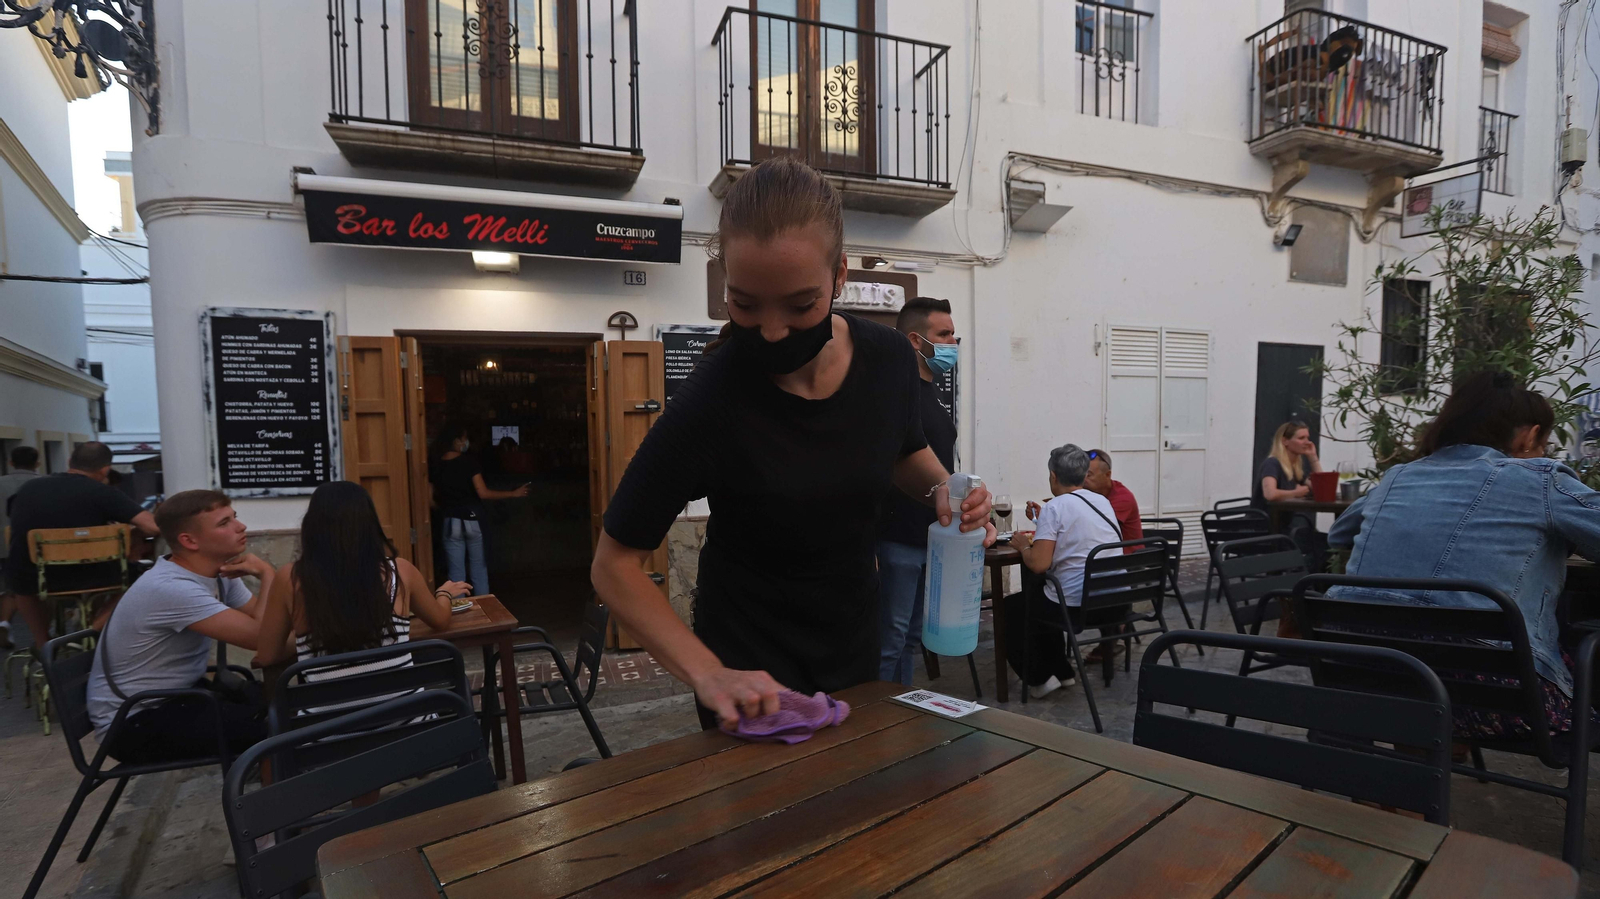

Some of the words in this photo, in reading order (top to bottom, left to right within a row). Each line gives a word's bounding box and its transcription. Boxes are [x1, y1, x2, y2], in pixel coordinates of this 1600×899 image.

[335, 204, 397, 236] Bar
[408, 212, 450, 240] los
[463, 213, 548, 244] Melli
[596, 223, 655, 239] Cruzcampo
[629, 272, 643, 283] 16
